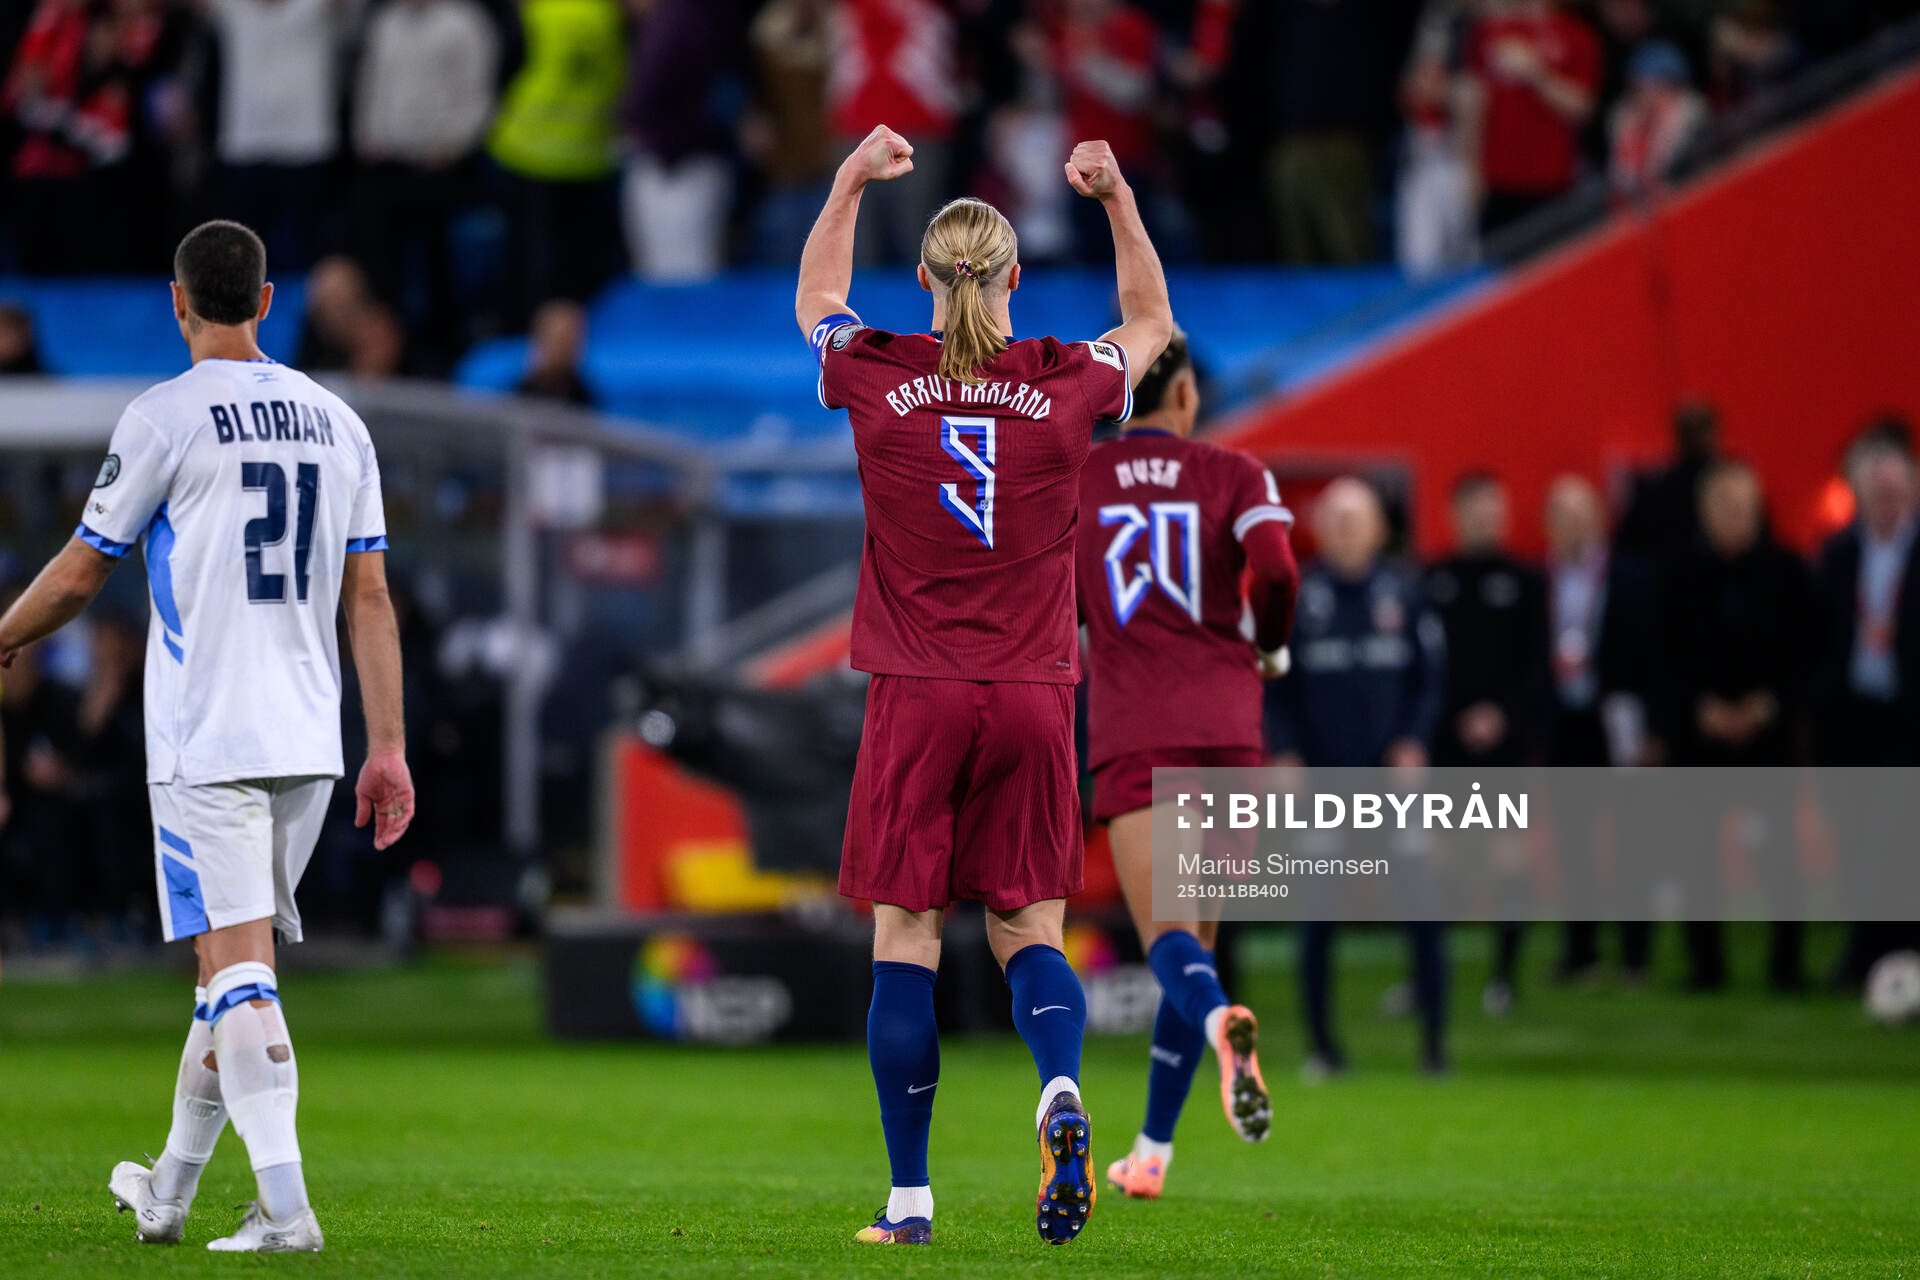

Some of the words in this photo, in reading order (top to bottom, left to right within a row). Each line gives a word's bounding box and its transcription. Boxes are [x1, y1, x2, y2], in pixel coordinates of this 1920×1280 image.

[209, 400, 335, 447] BLORIAN
[939, 416, 996, 550] 9
[241, 462, 320, 604] 21
[1098, 502, 1202, 629] 20
